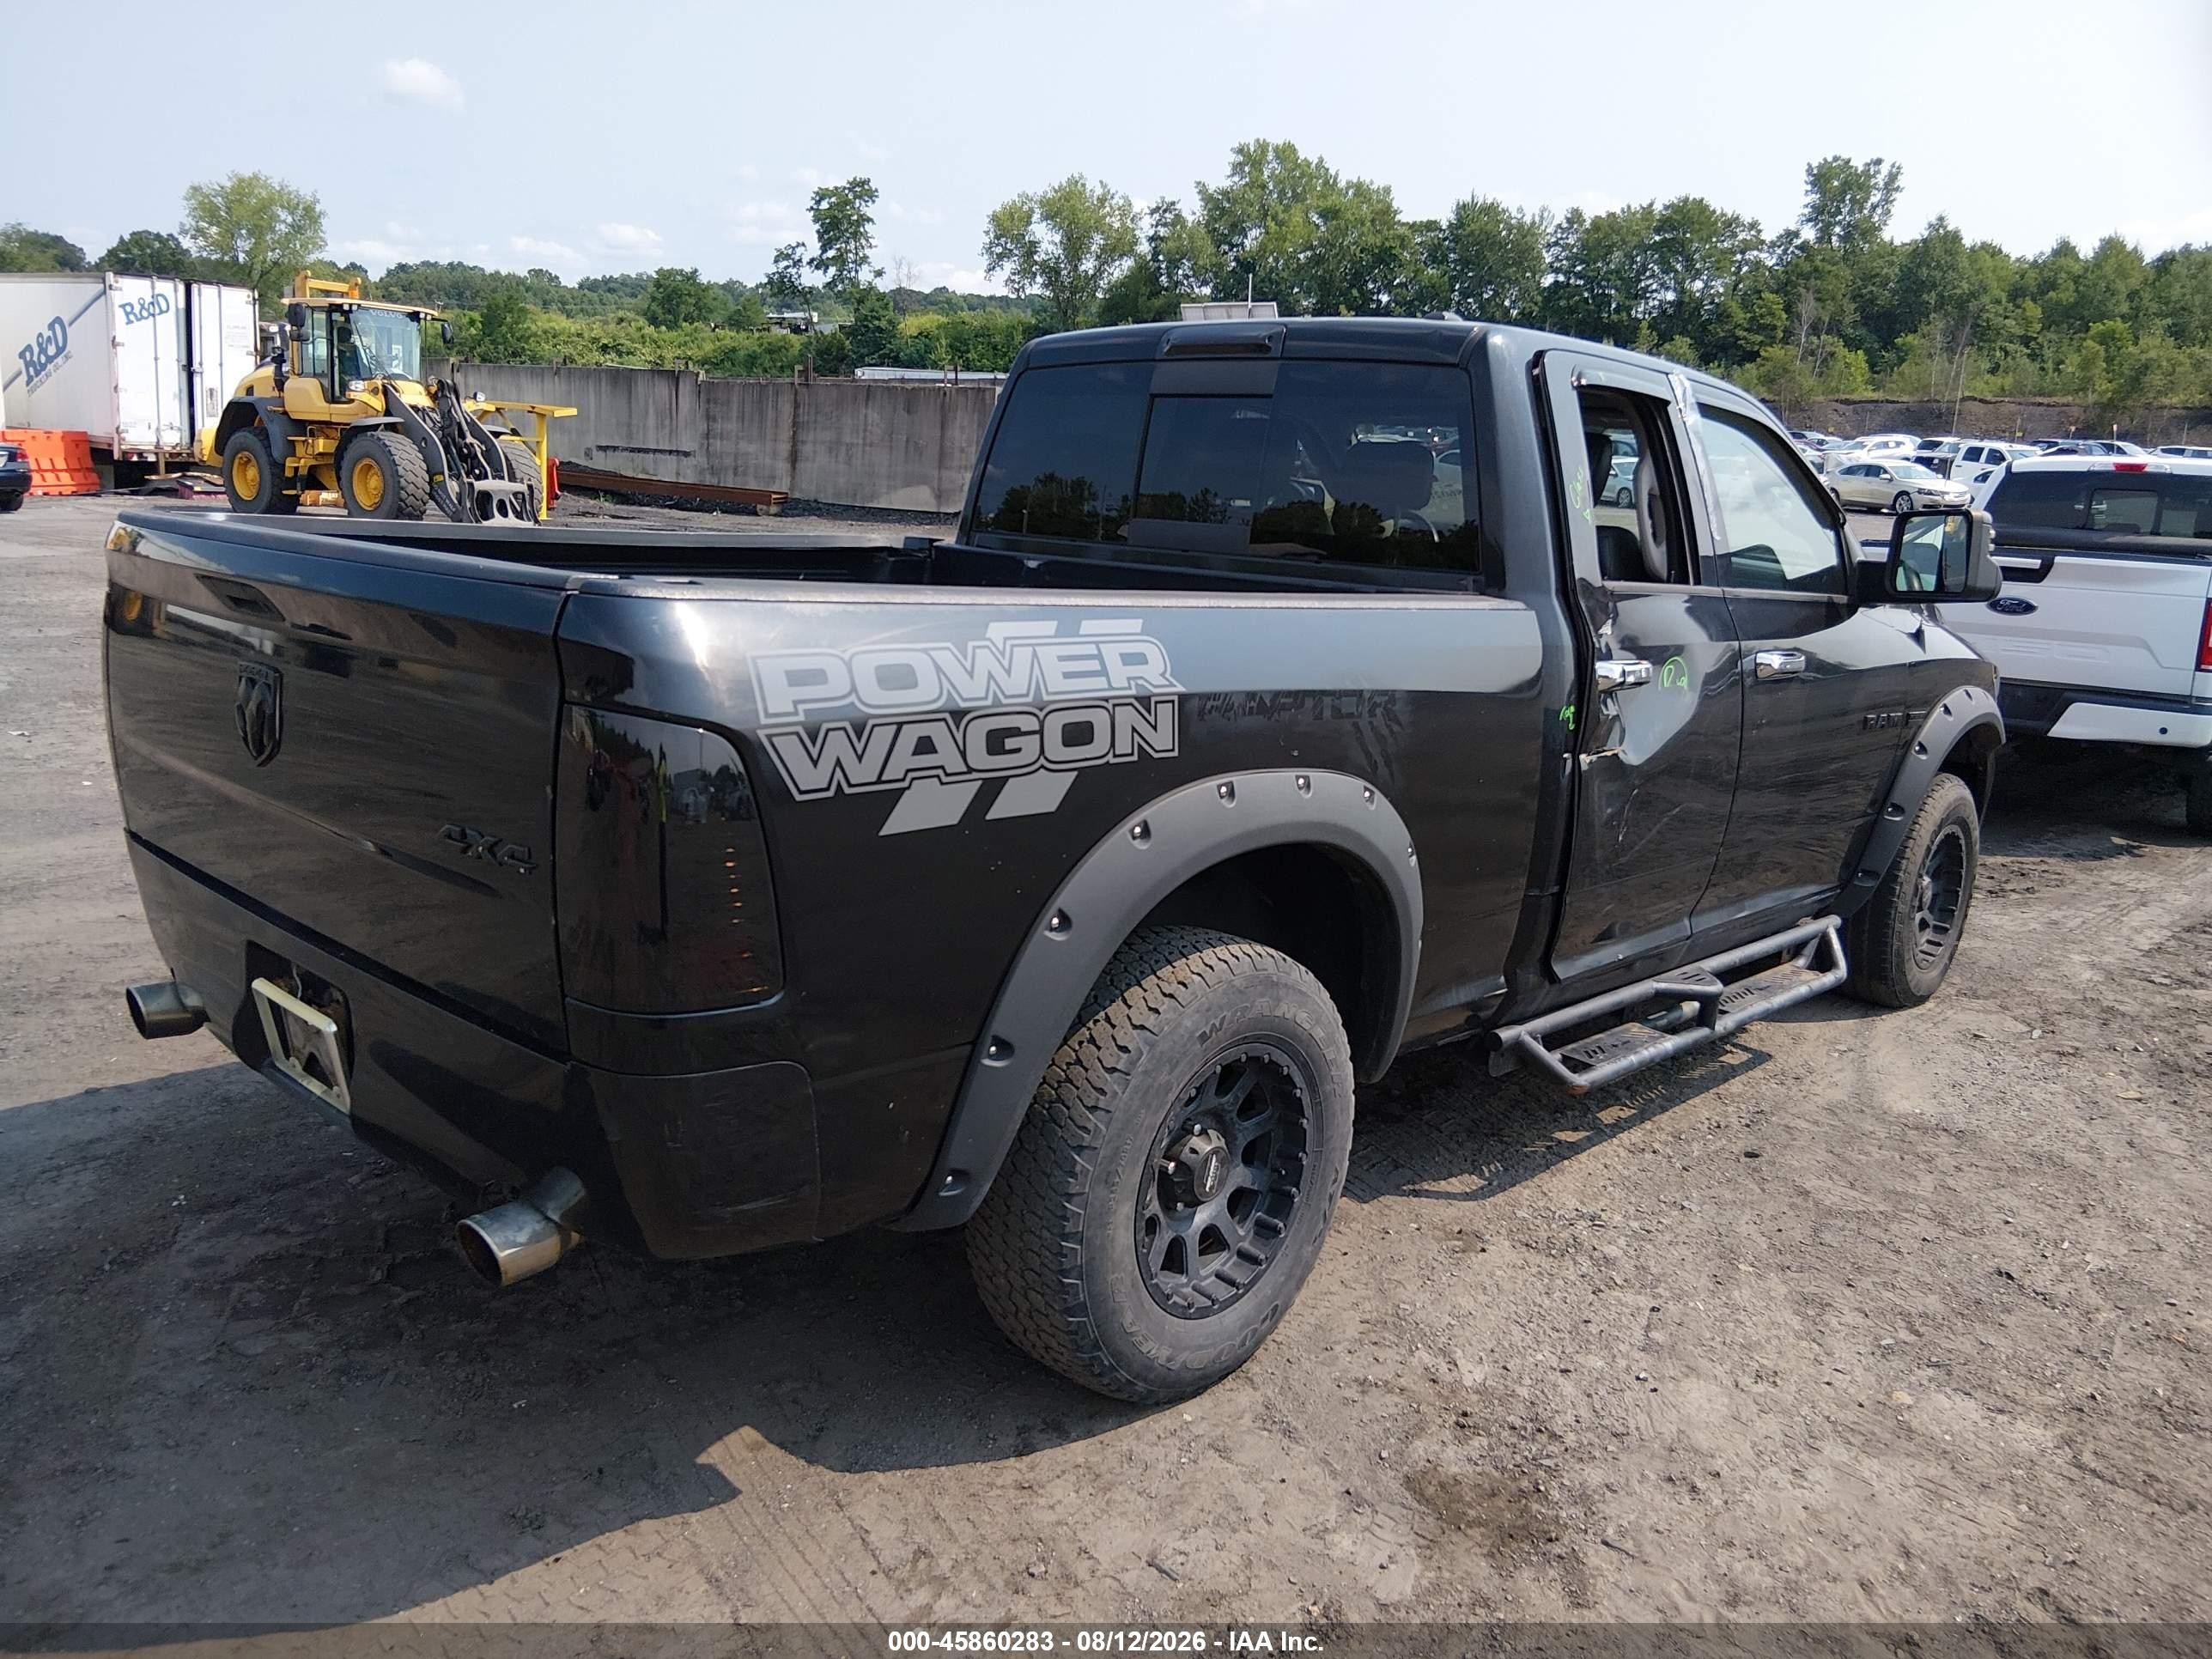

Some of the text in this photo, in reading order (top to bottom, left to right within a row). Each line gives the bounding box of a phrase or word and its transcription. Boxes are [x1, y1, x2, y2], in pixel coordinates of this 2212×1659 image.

[118, 293, 170, 325] R&D
[370, 309, 404, 319] VOLVO
[18, 315, 68, 386] R&D
[747, 635, 1186, 724] POWER
[757, 695, 1181, 801] WAGON
